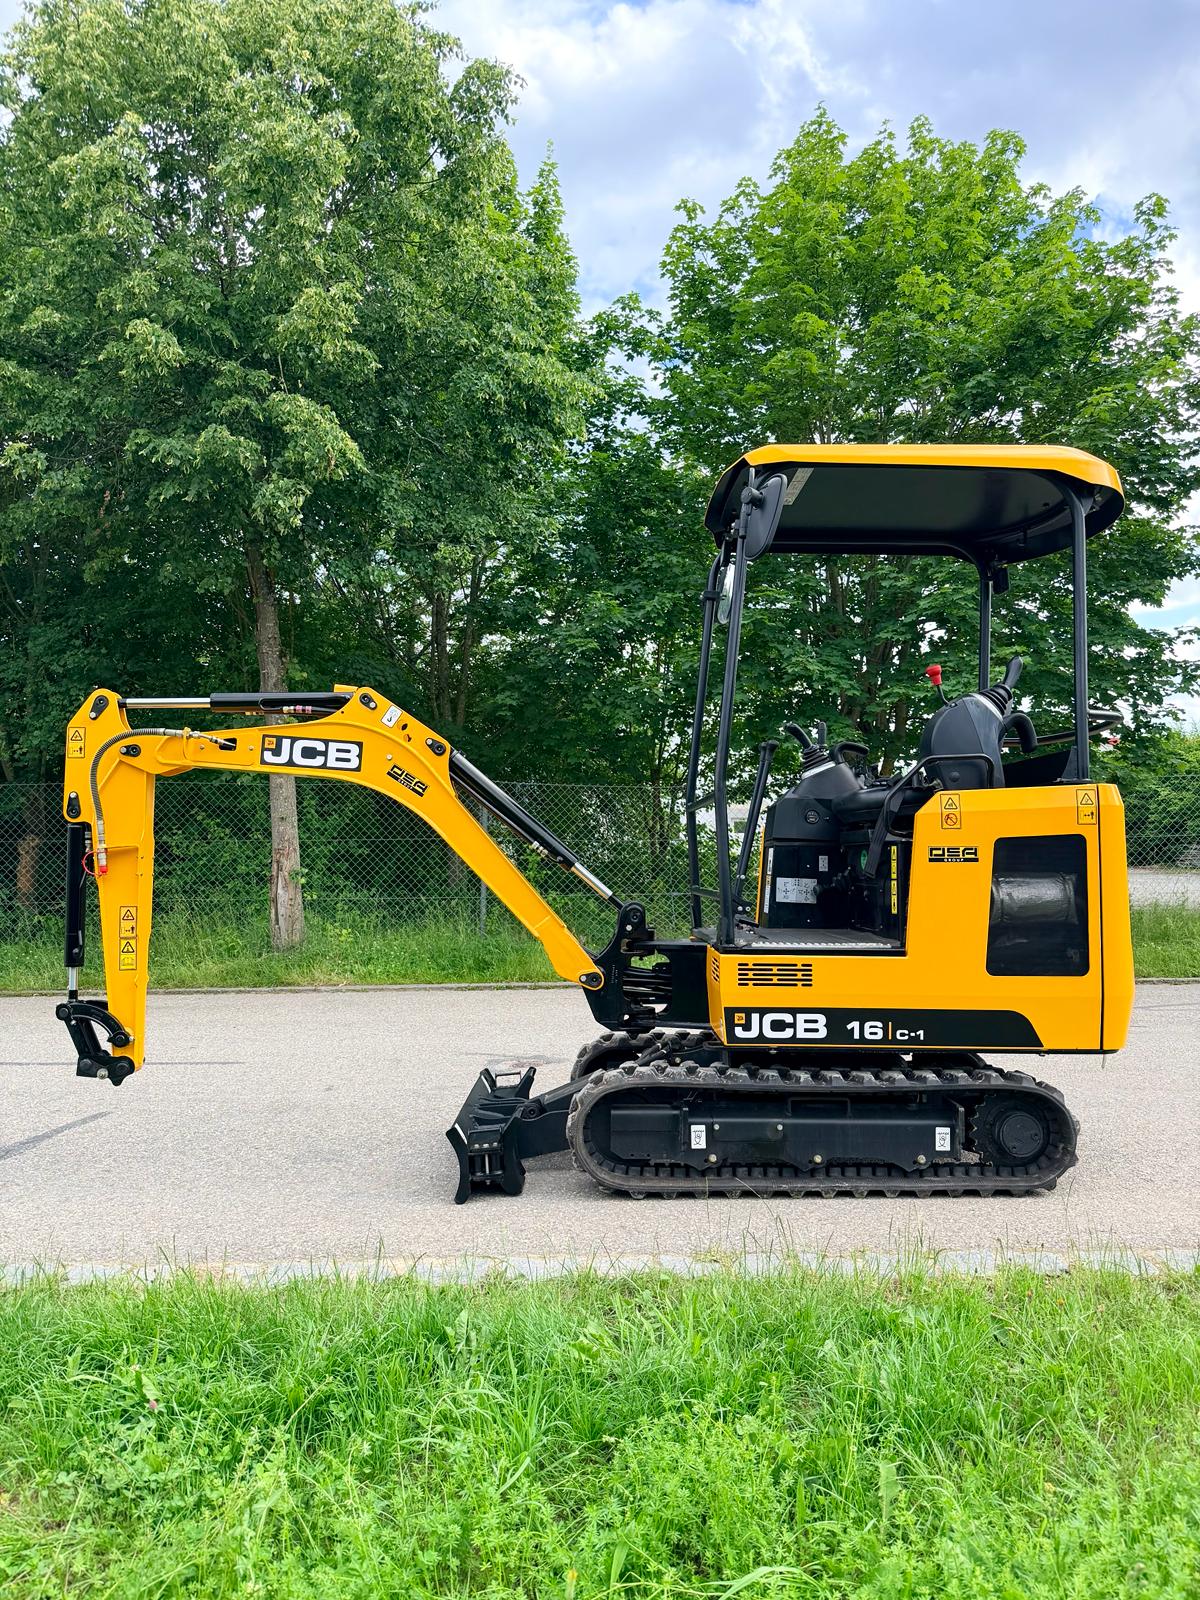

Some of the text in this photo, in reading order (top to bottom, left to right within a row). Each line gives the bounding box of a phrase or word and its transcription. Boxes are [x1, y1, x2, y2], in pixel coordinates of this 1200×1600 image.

[264, 738, 360, 769] JCB
[734, 1012, 828, 1039] JCB
[846, 1020, 884, 1040] 16
